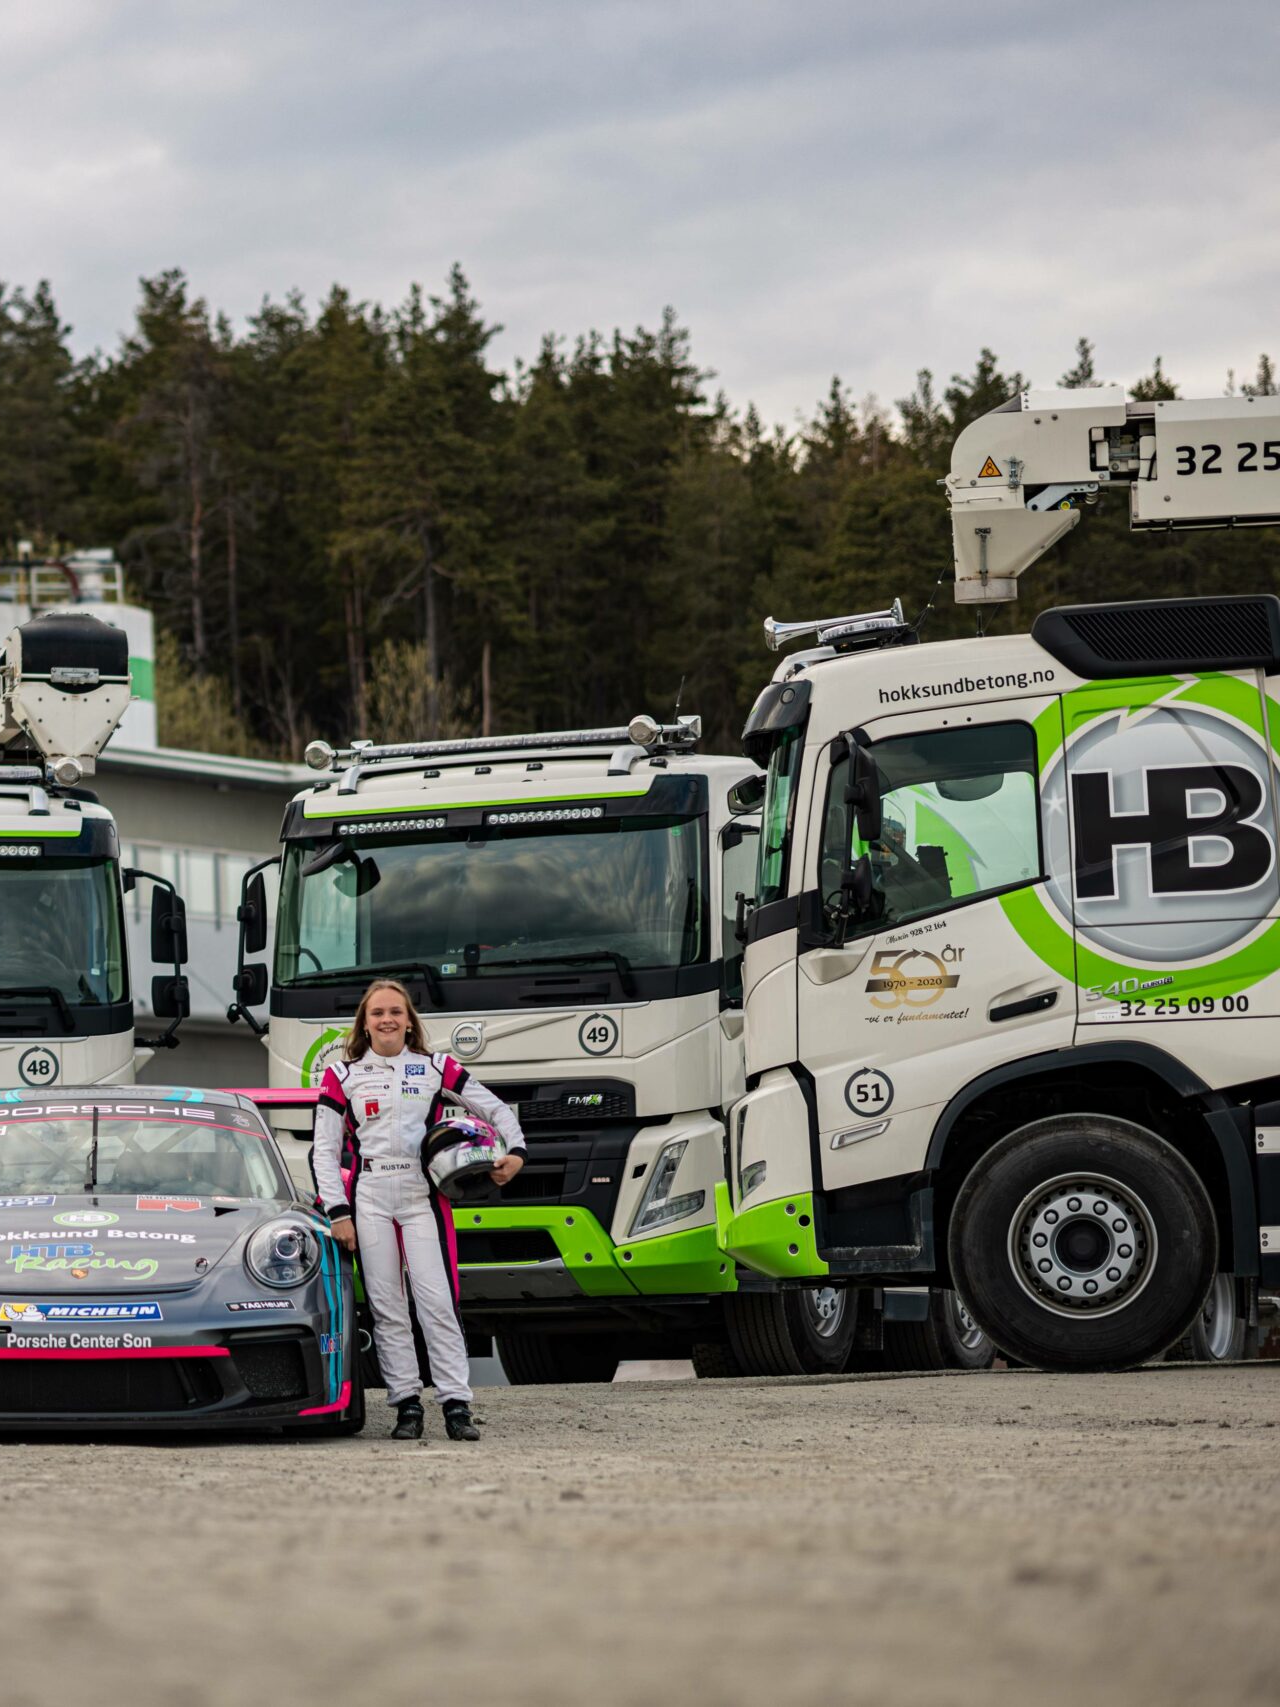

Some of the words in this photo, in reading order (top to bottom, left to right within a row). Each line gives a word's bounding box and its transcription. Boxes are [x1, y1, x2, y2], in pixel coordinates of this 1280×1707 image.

[1176, 444, 1222, 476] 32
[1237, 440, 1280, 473] 25
[879, 669, 1055, 704] hokksundbetong.no
[1069, 762, 1272, 901] HB
[941, 944, 965, 962] år
[883, 980, 907, 990] 1970
[917, 977, 943, 986] 2020
[1085, 977, 1139, 1001] 540
[1121, 1000, 1146, 1016] 32
[1154, 998, 1180, 1015] 25
[1188, 996, 1215, 1014] 09
[1222, 995, 1249, 1012] 00
[884, 1015, 894, 1023] er
[897, 1008, 969, 1025] fundamentet!
[586, 1026, 609, 1043] 49
[27, 1060, 50, 1076] 48
[856, 1083, 884, 1102] 51
[381, 1163, 411, 1171] RUSTAD
[108, 1230, 197, 1244] Betong
[10, 1243, 94, 1259] HTB
[5, 1252, 159, 1280] Racing
[48, 1306, 156, 1315] MICHELIN
[7, 1333, 66, 1348] Porsche
[70, 1333, 120, 1348] Center
[123, 1333, 152, 1348] Son
